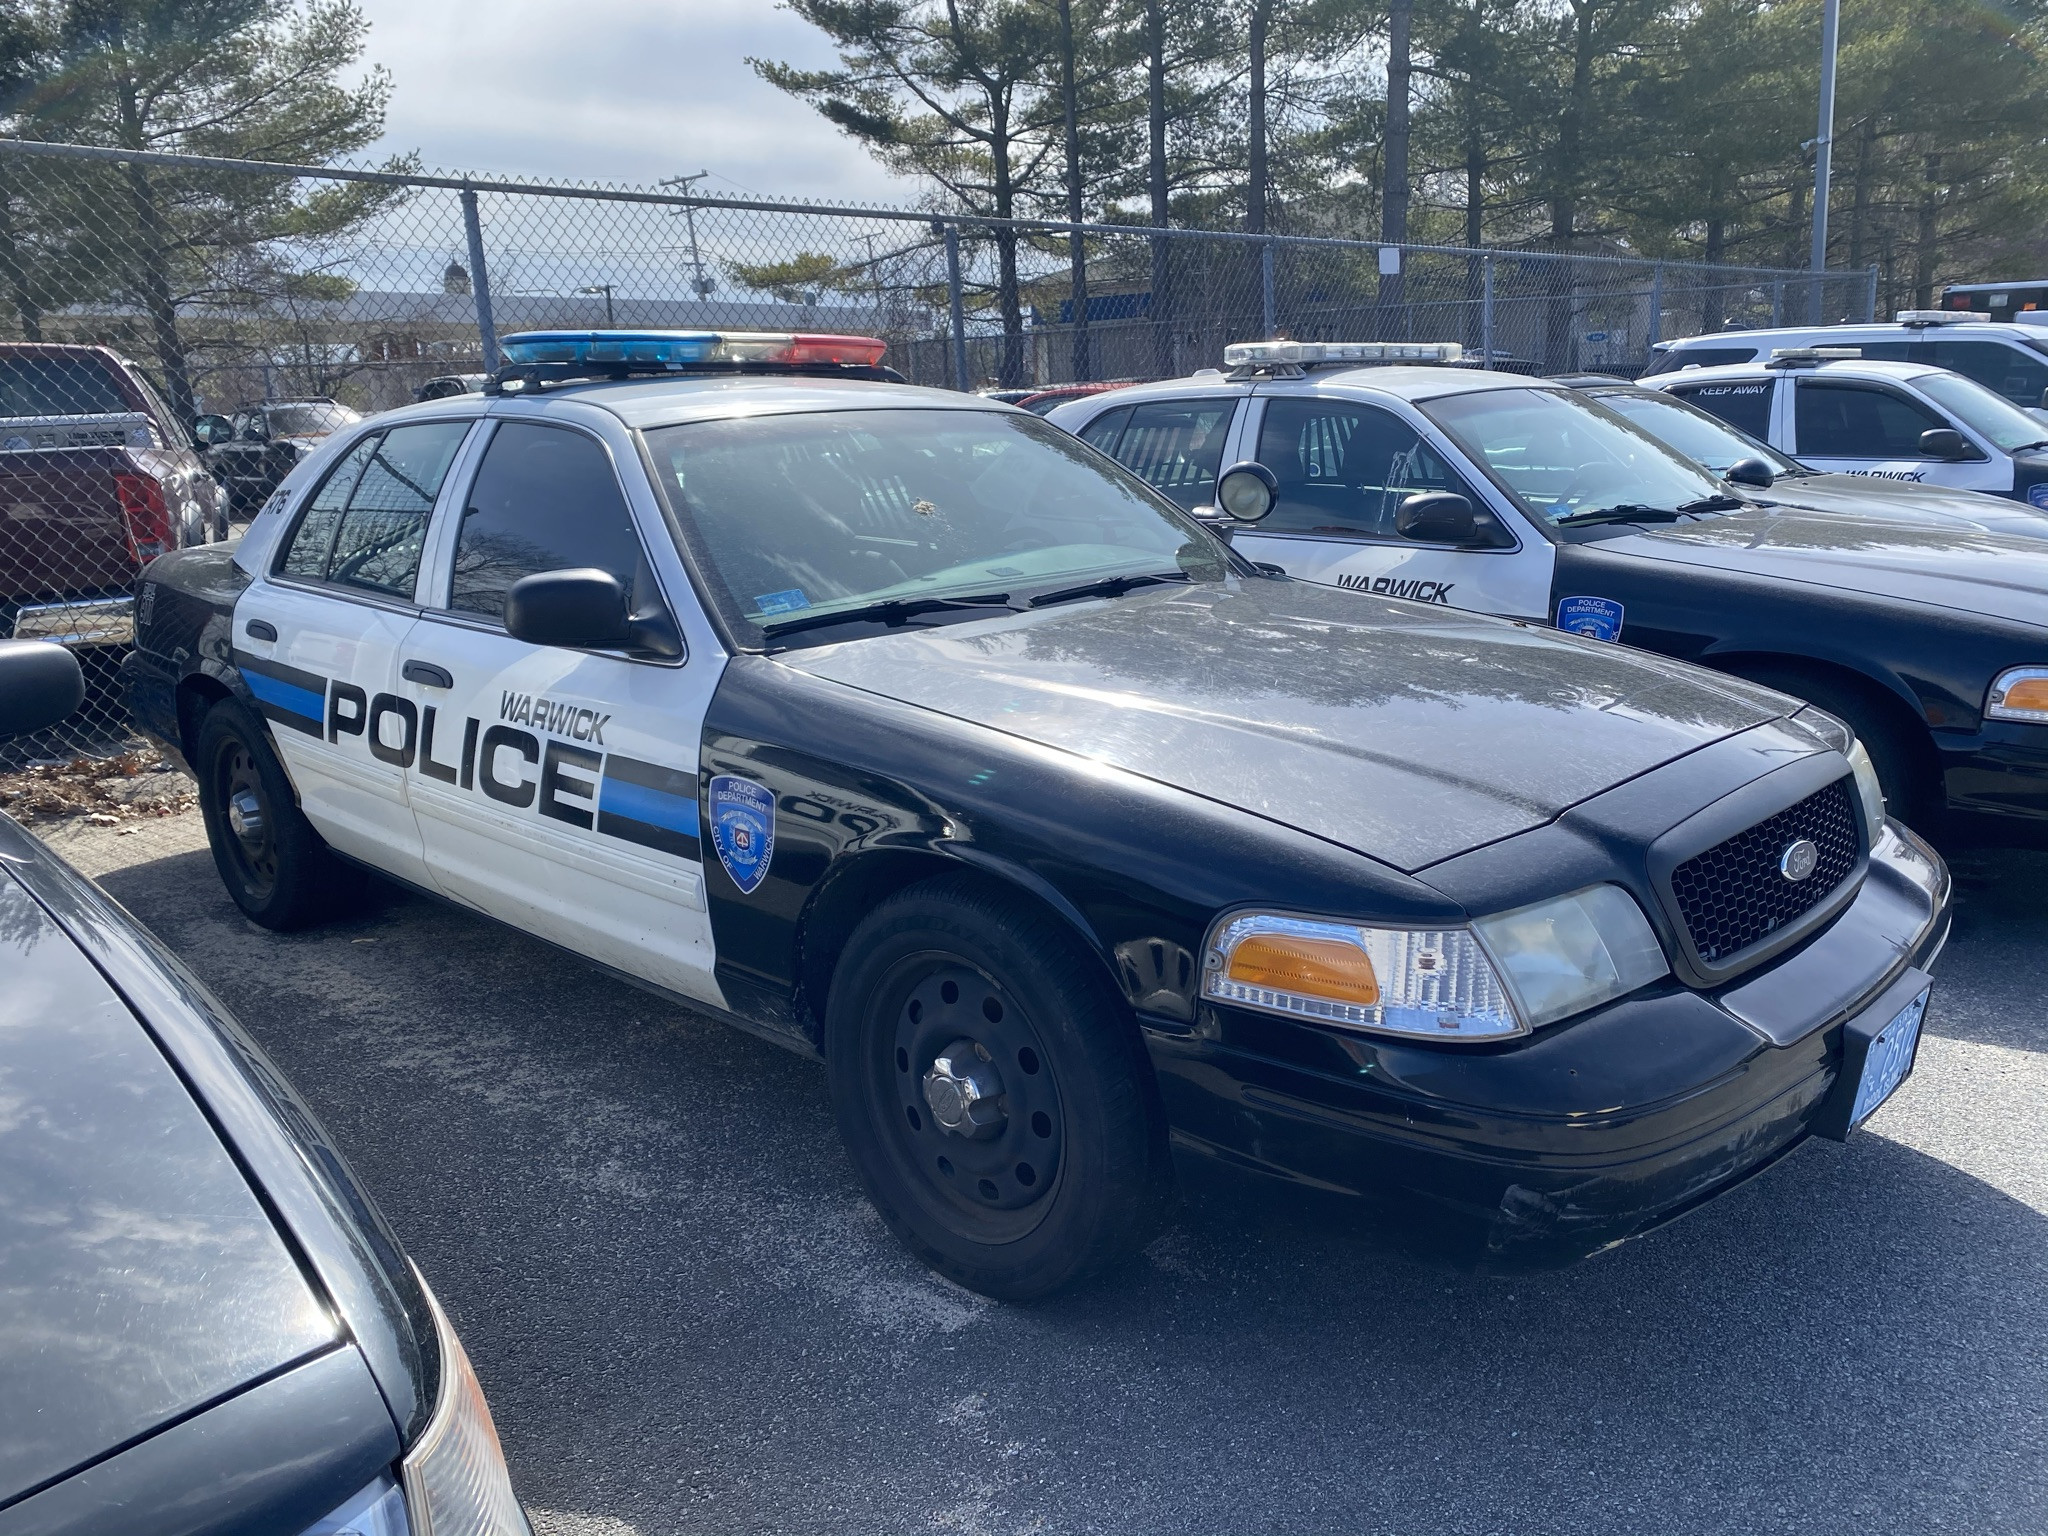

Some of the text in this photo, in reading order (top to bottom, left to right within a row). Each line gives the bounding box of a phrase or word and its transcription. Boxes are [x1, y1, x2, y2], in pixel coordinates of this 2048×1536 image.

[1699, 385, 1768, 396] KEEP AWAY
[1337, 574, 1456, 604] WARWICK
[1567, 606, 1615, 617] DEPARTMENT
[1578, 599, 1606, 609] POLICE
[500, 690, 611, 746] WARWICK
[328, 679, 604, 831] POLICE
[728, 781, 757, 797] POLICE
[718, 791, 767, 812] DEPARTMENT
[713, 825, 725, 851] CITY
[723, 855, 734, 869] OF
[753, 835, 772, 880] WARWICK
